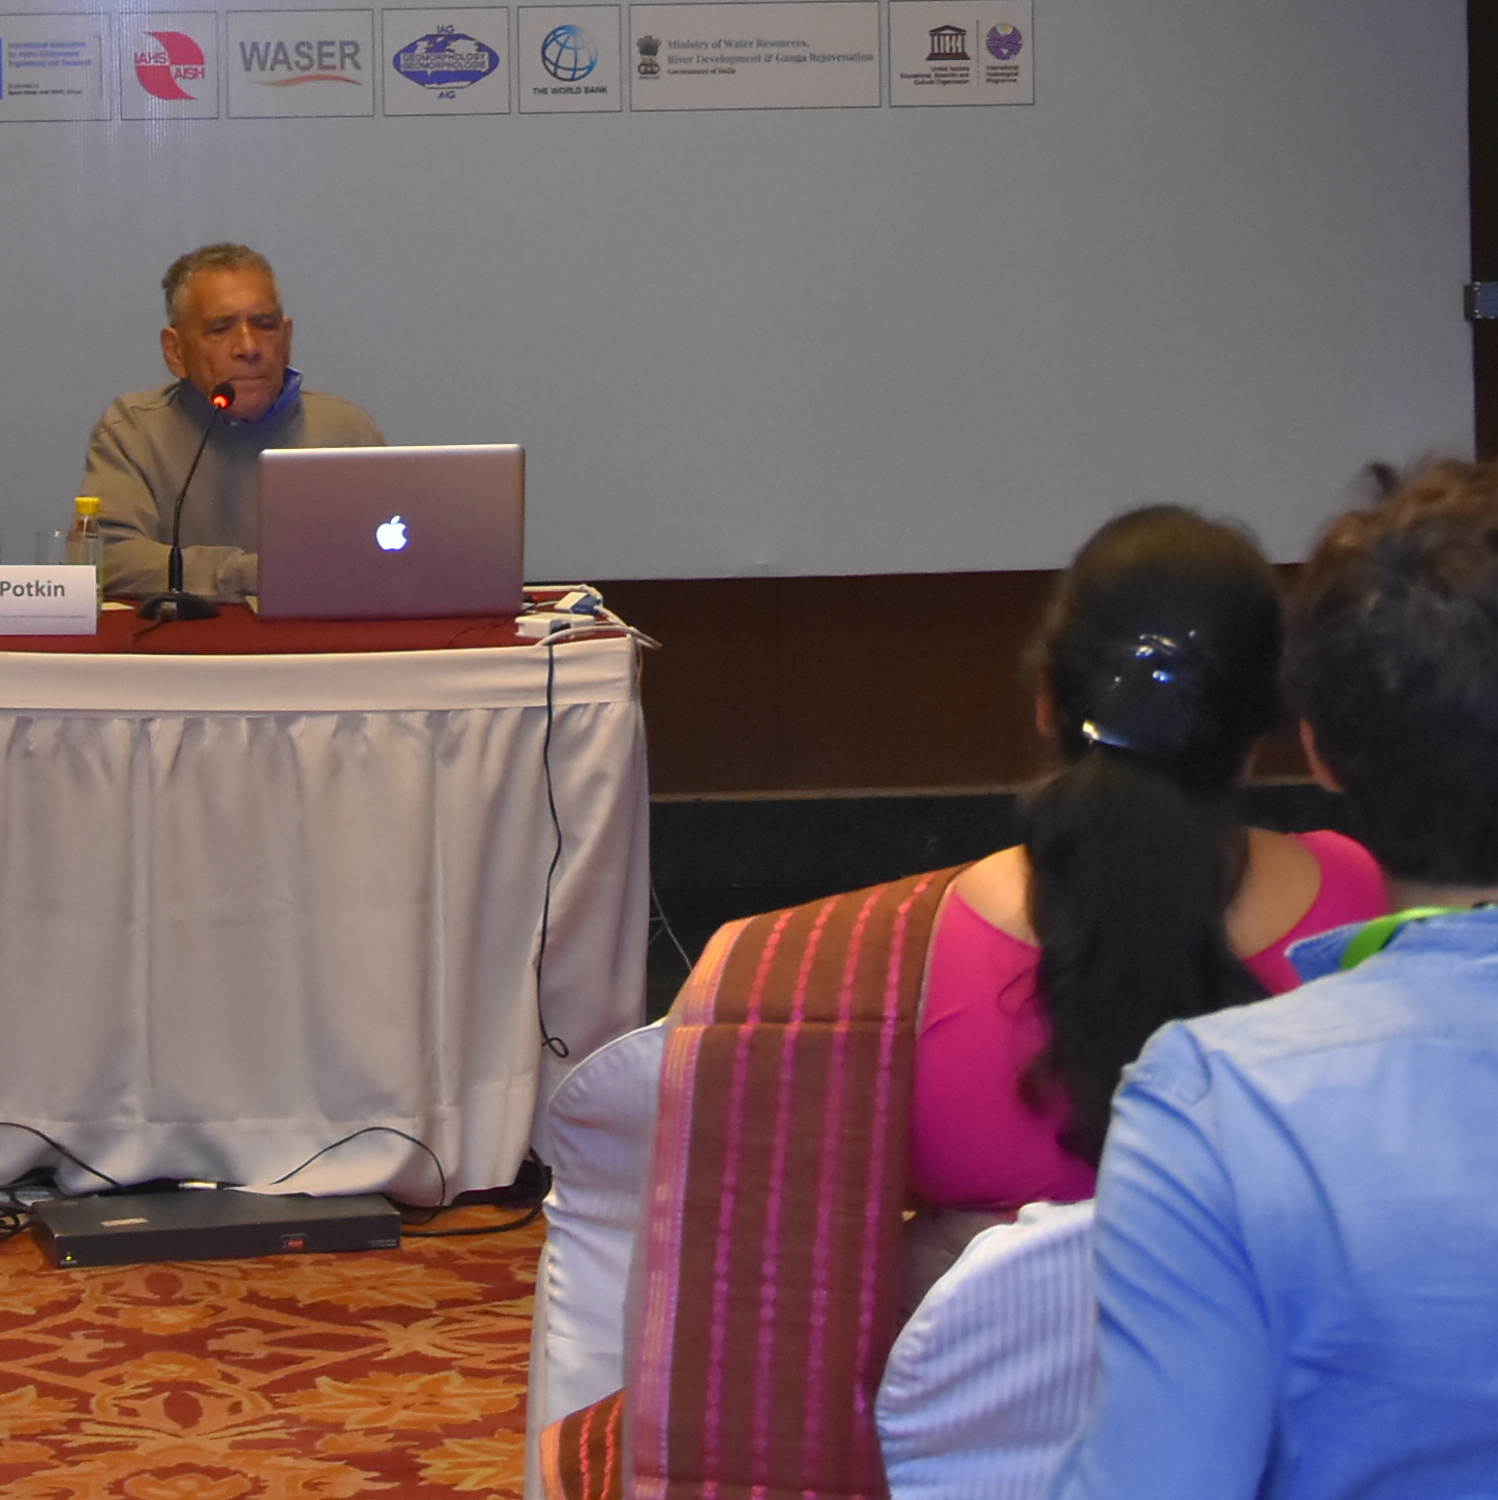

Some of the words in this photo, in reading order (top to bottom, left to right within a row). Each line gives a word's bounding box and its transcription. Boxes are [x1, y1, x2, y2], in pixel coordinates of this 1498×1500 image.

[668, 40, 709, 50] Ministry
[712, 40, 723, 49] of
[724, 39, 753, 49] Water
[134, 52, 167, 64] IAHS
[239, 40, 362, 72] WASER
[668, 55, 693, 64] River
[696, 54, 761, 66] Development
[776, 53, 807, 63] Ganga
[174, 67, 205, 80] AISH
[437, 91, 456, 99] AIG
[533, 87, 548, 95] THE
[550, 87, 582, 95] WORLD
[584, 86, 607, 94] BANK
[0, 580, 65, 597] Potkin
